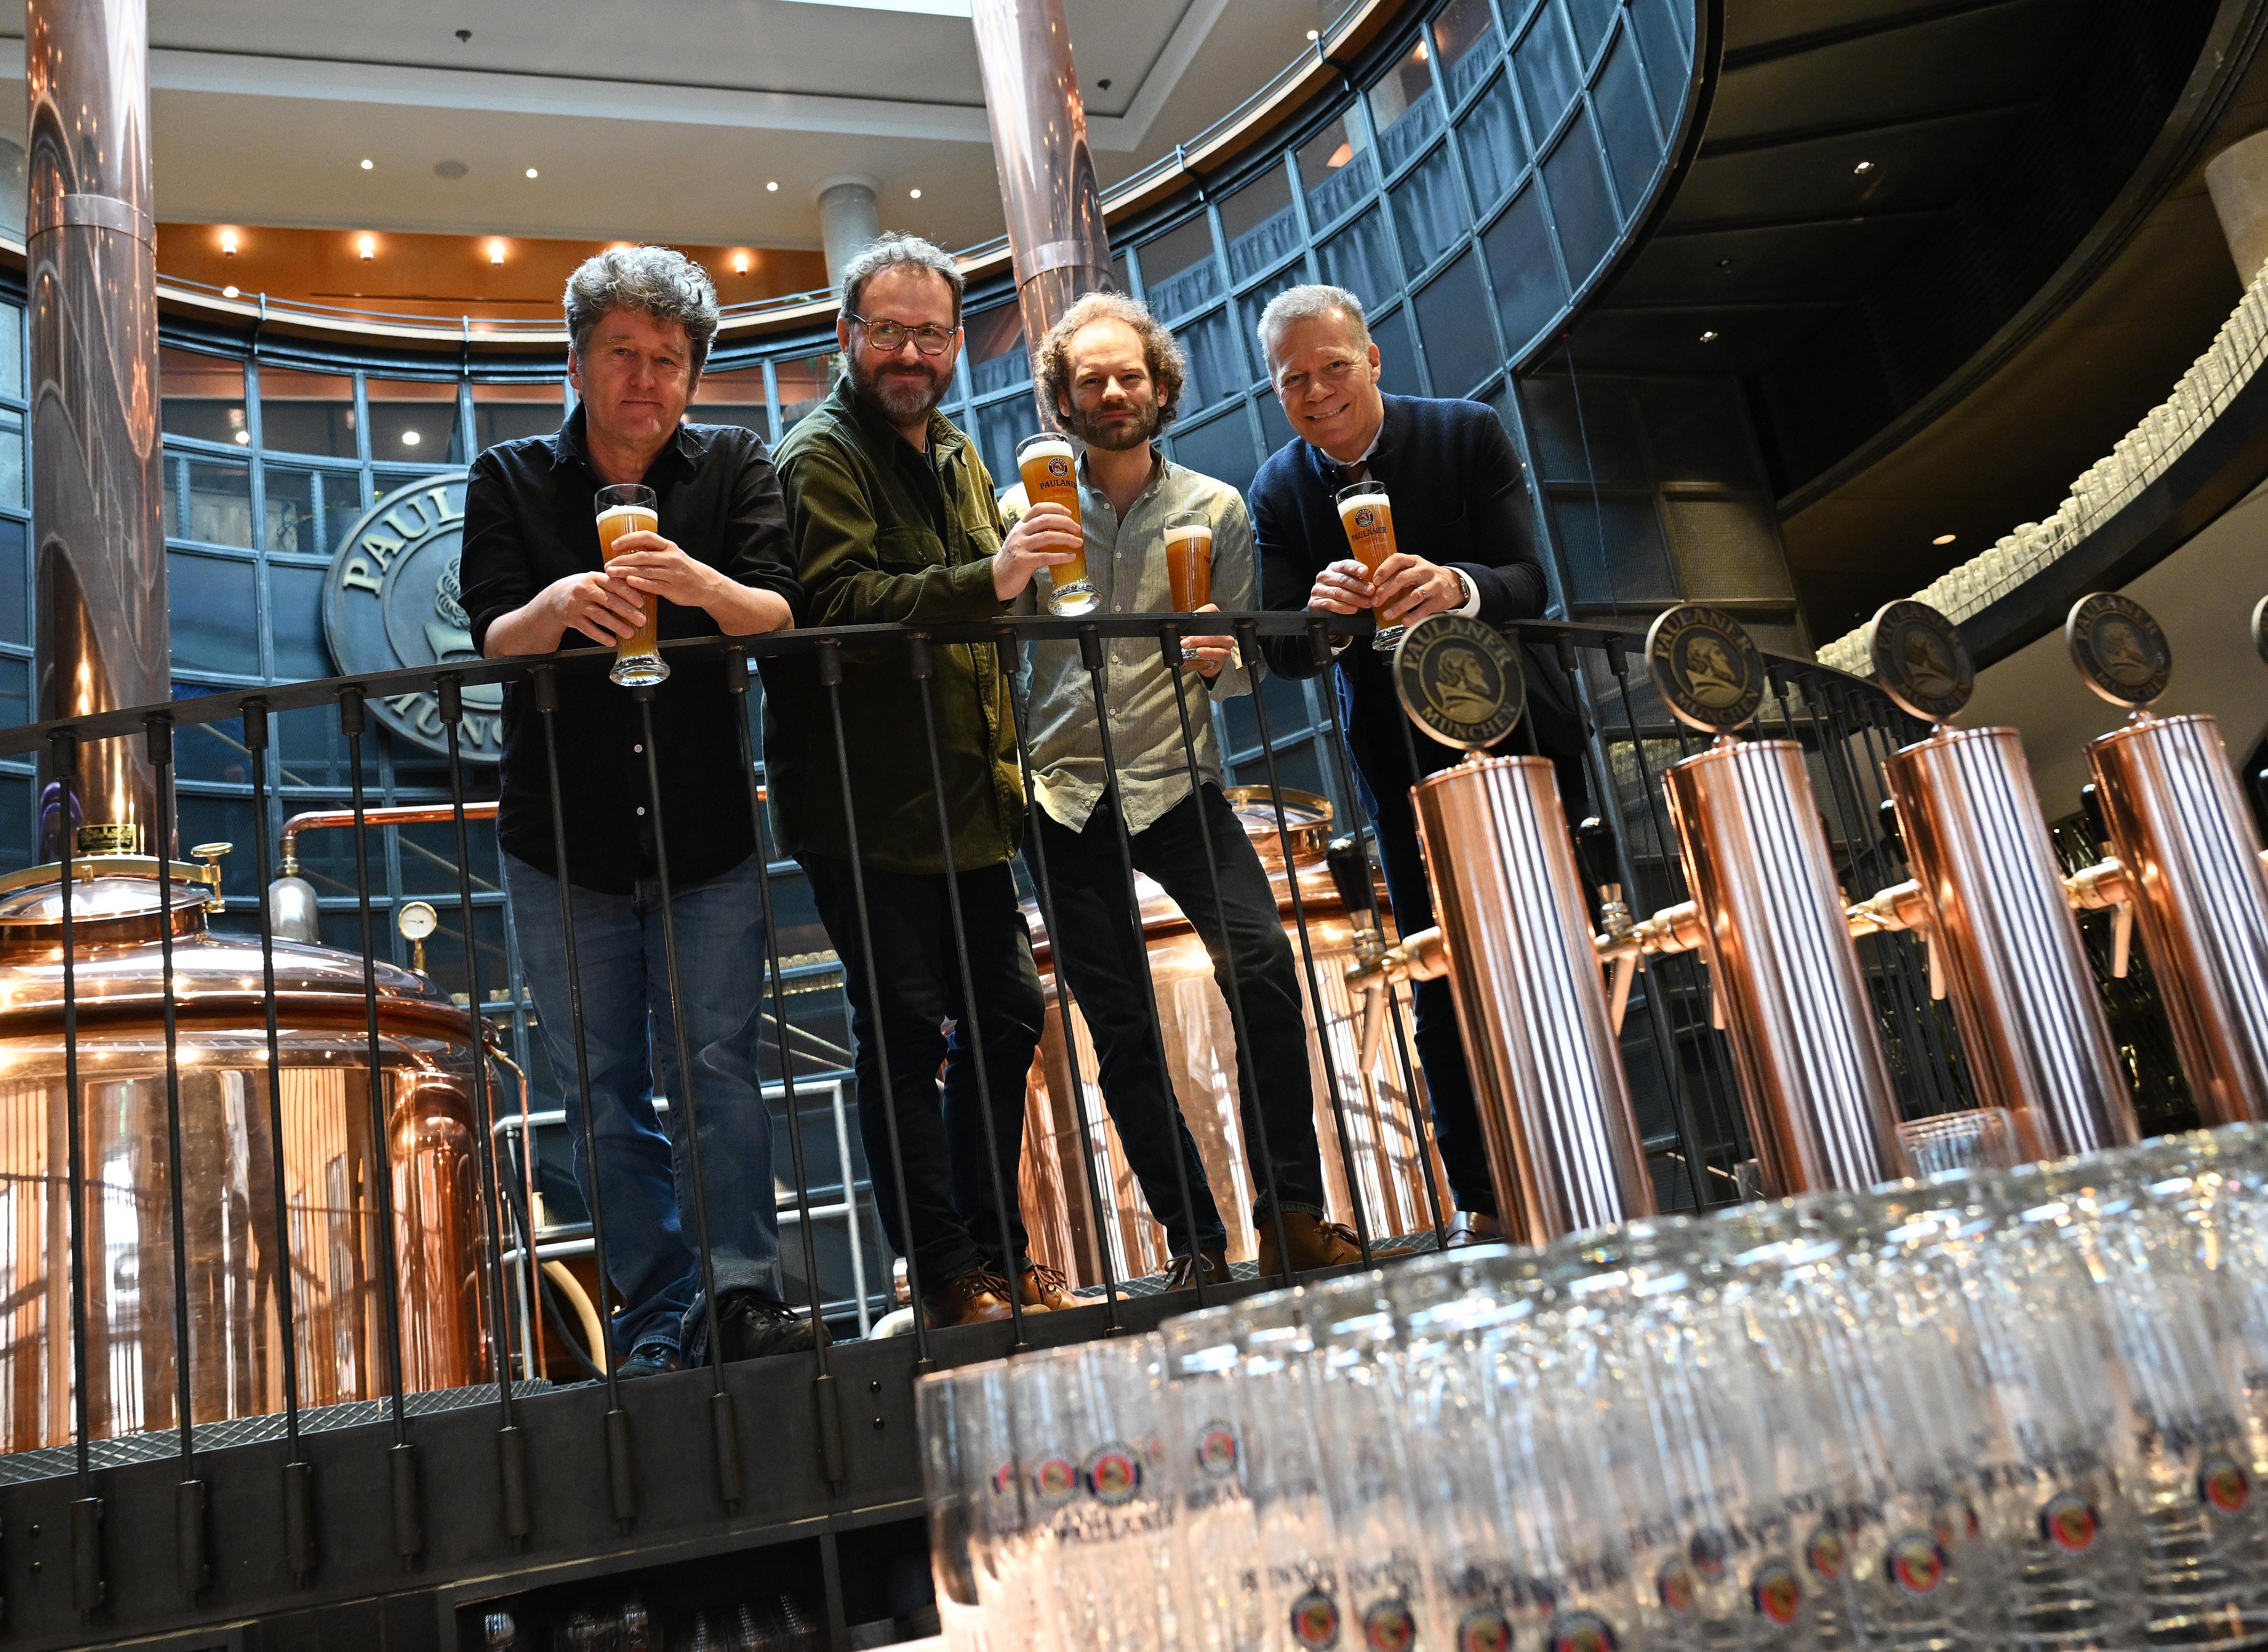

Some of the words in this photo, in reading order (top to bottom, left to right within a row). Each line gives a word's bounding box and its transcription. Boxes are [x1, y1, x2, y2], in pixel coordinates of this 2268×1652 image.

[343, 486, 466, 596] PAUL
[1351, 526, 1387, 542] PAULANER
[1403, 617, 1511, 671] PAULANER
[1654, 608, 1752, 660] PAULANER
